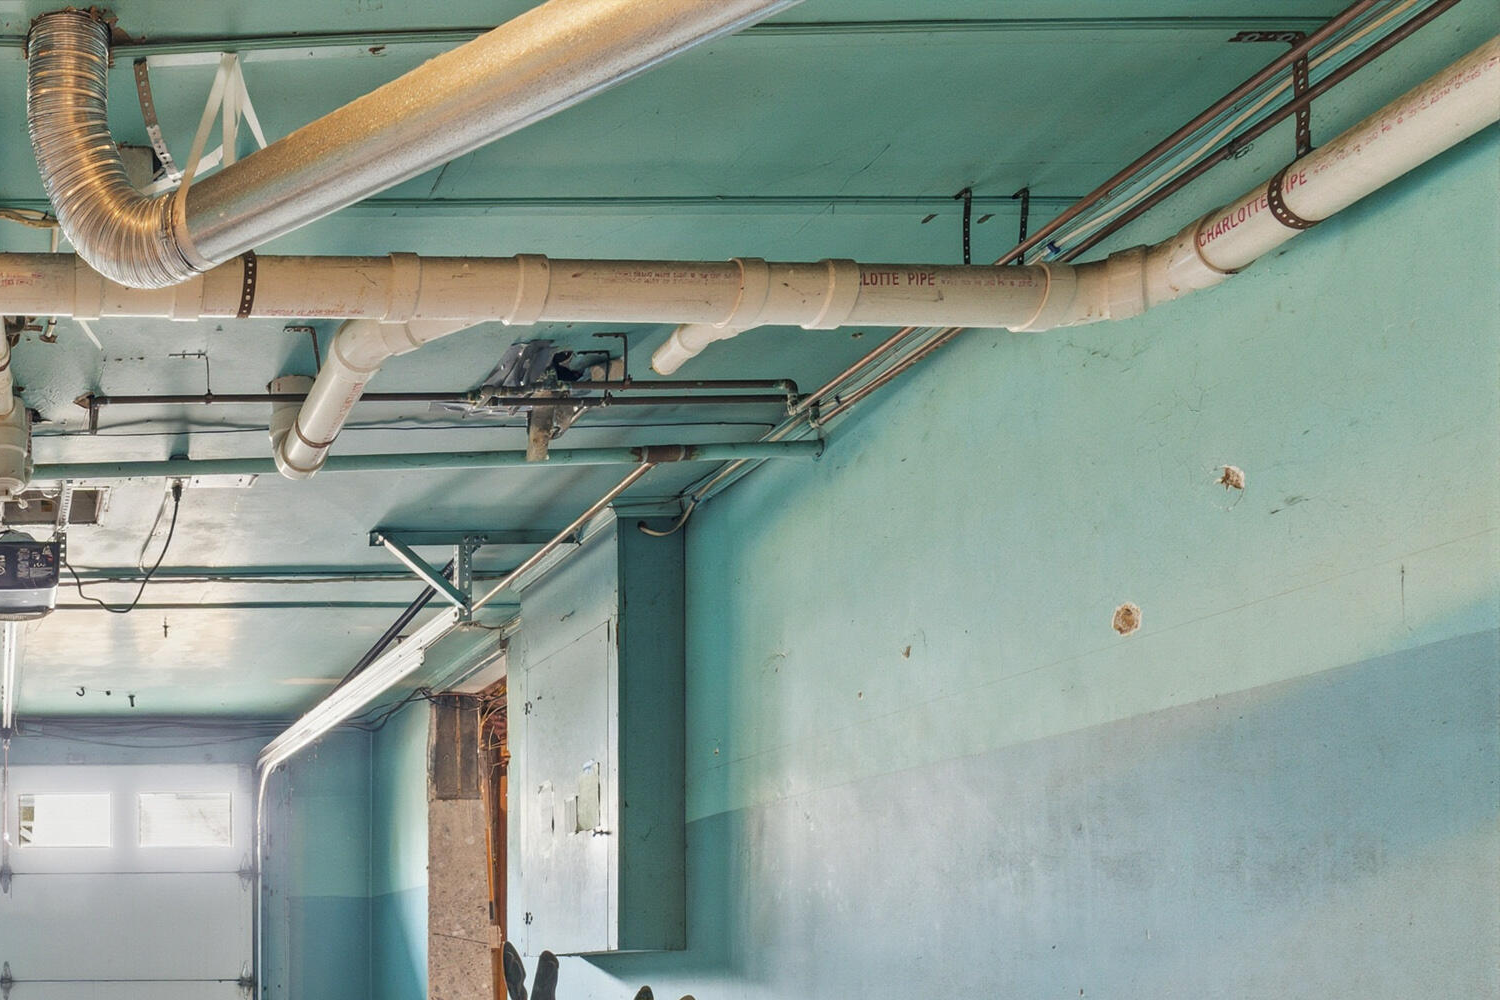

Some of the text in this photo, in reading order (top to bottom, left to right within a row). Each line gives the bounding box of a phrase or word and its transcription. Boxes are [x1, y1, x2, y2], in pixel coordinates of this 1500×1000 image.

[1198, 194, 1269, 248] CHARLOTTE
[860, 272, 899, 286] LOTTE
[908, 272, 935, 286] PIPE
